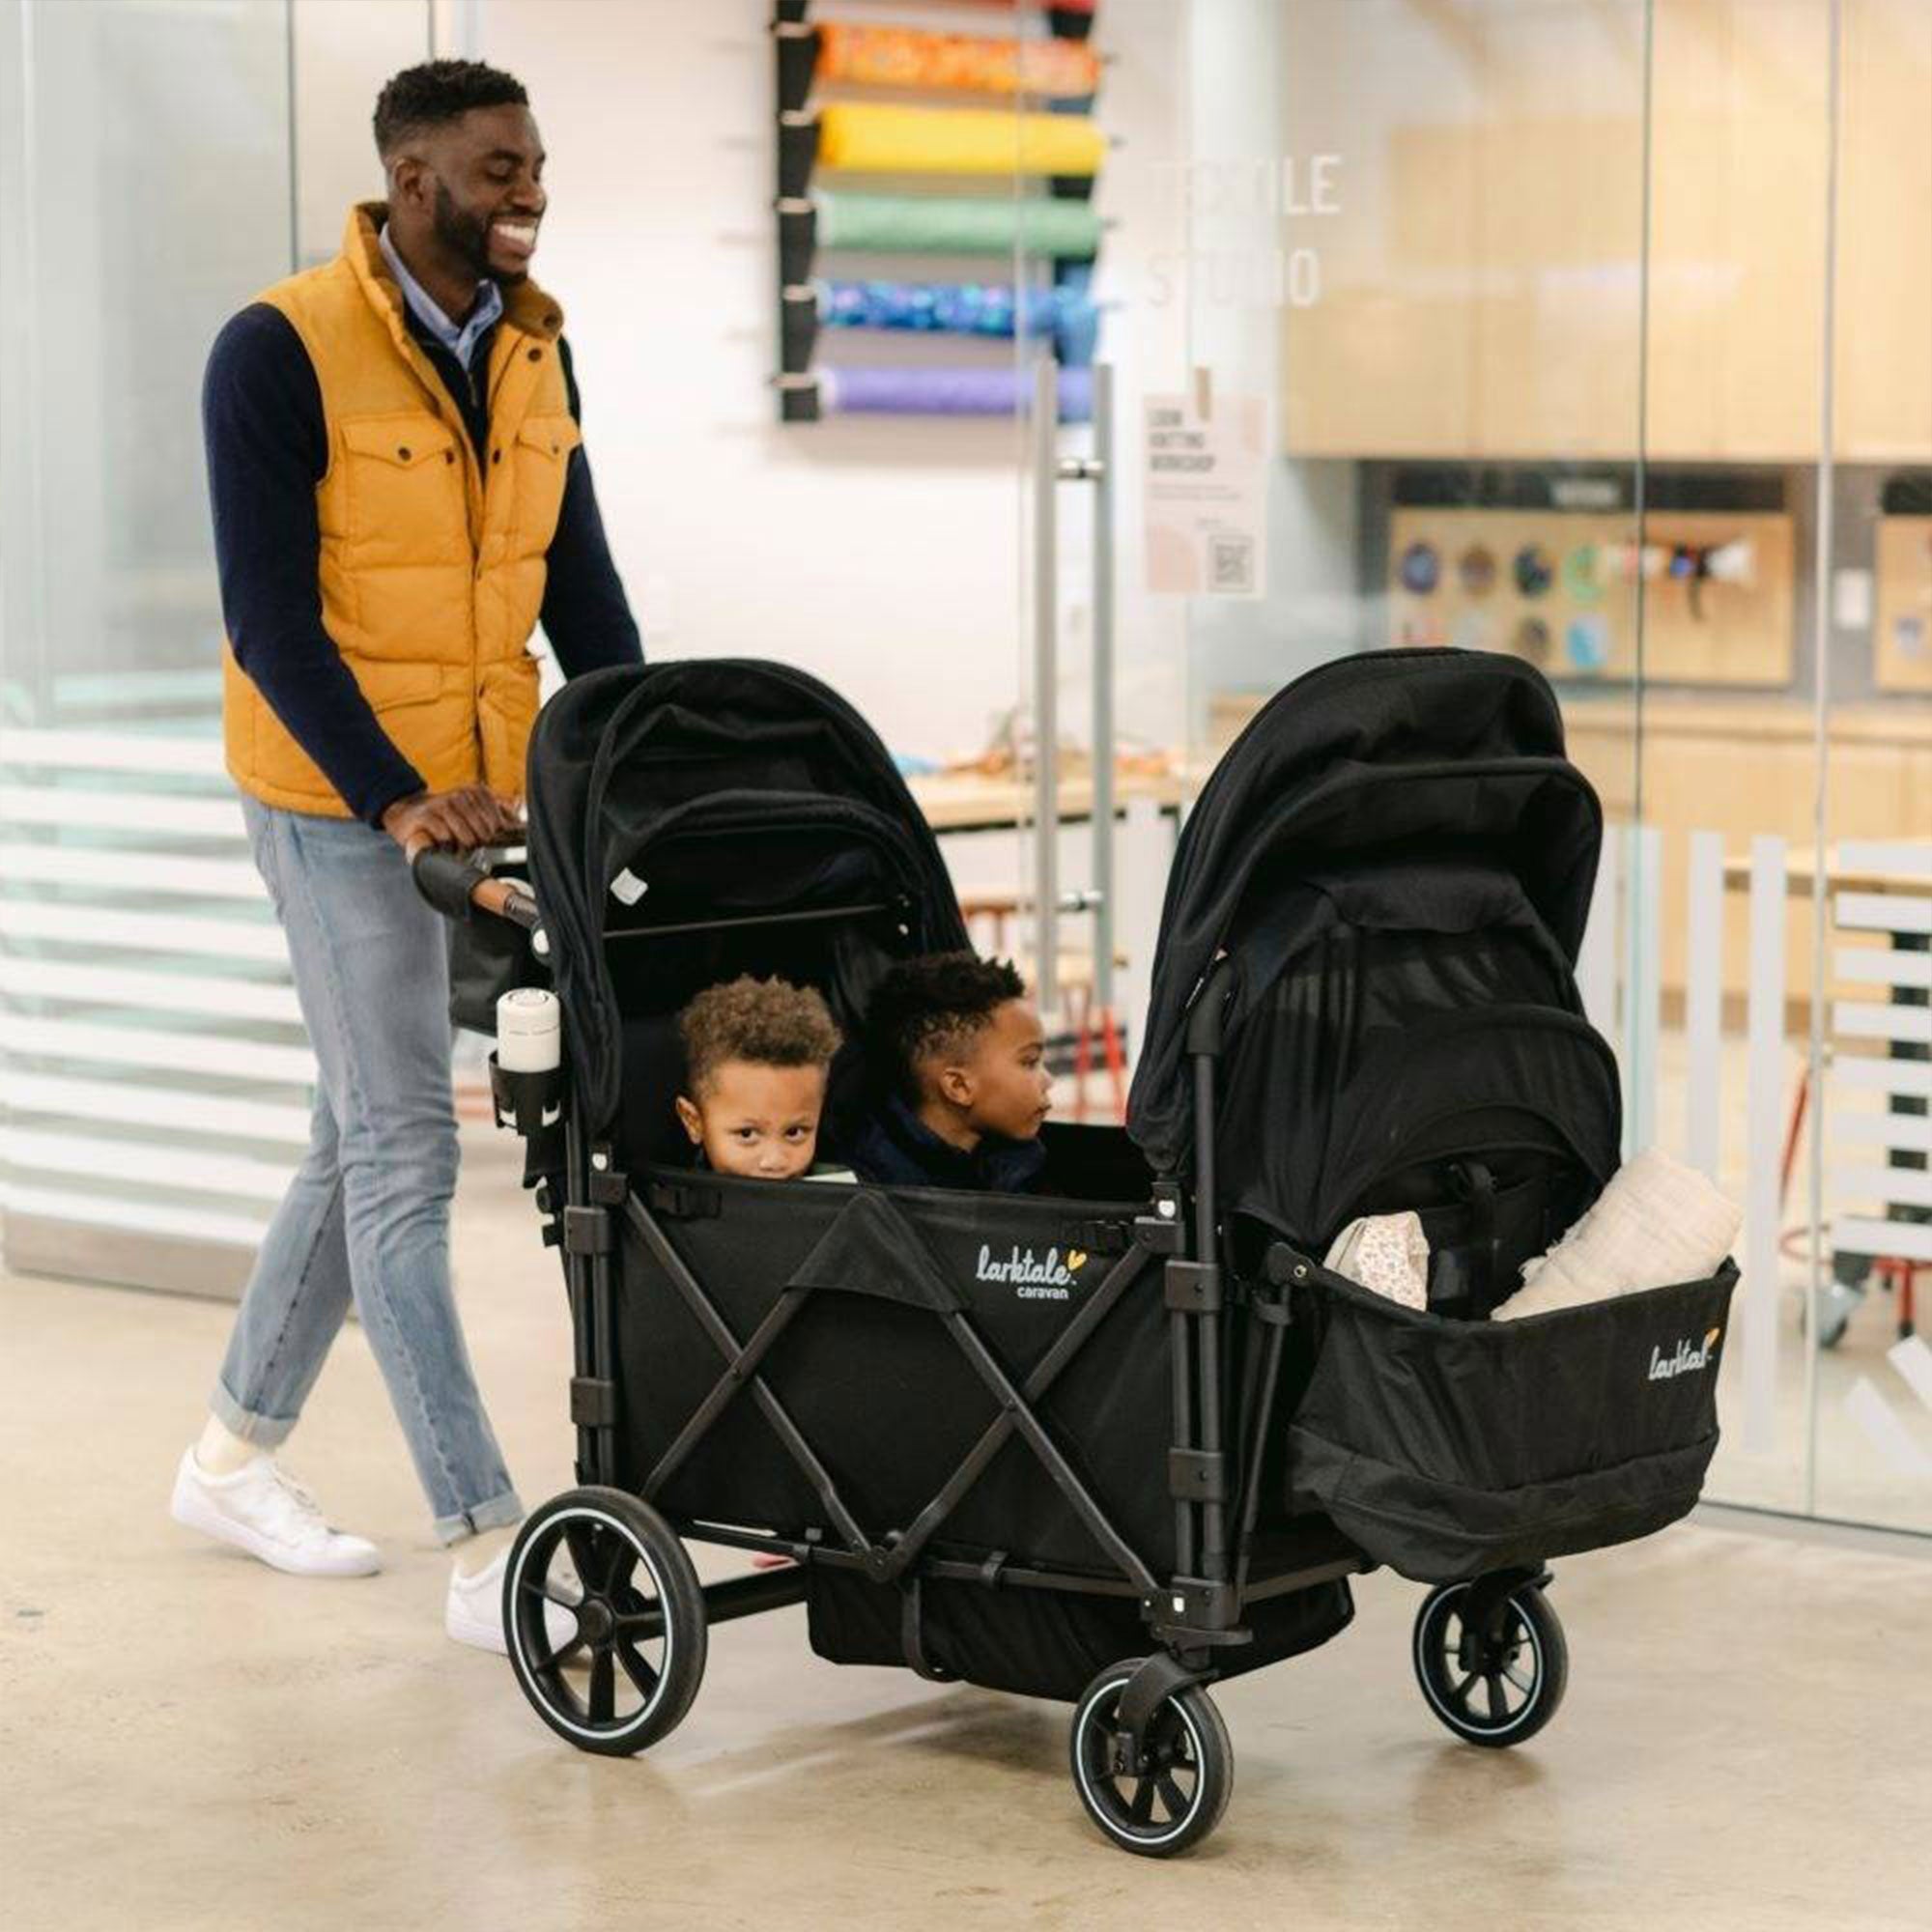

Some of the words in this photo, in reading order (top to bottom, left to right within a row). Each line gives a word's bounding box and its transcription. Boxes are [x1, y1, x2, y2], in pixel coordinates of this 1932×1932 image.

[976, 1244, 1071, 1286] larktale
[1017, 1286, 1069, 1300] caravan
[1648, 1333, 1708, 1380] larktal
